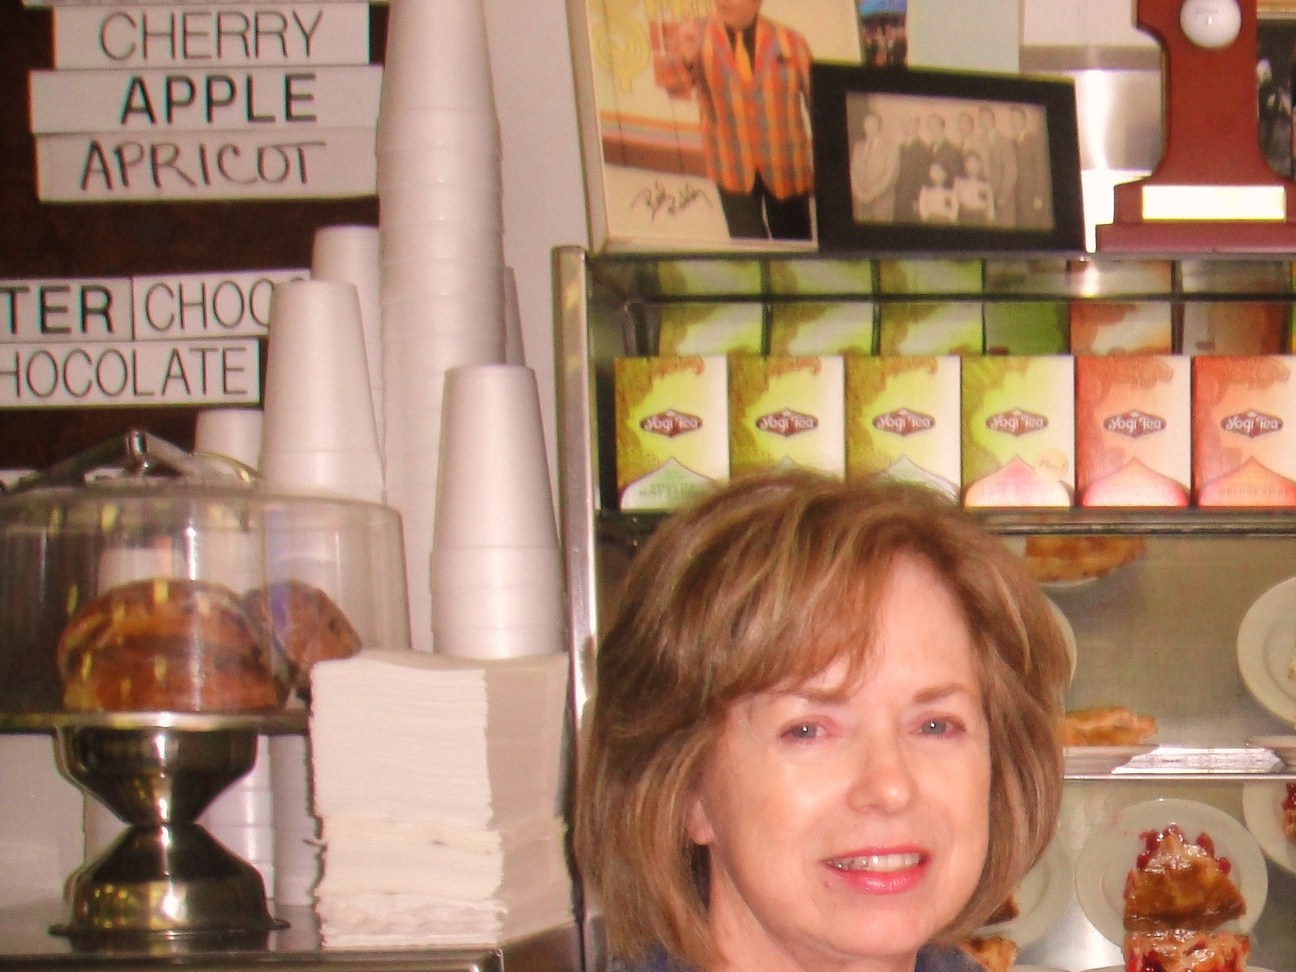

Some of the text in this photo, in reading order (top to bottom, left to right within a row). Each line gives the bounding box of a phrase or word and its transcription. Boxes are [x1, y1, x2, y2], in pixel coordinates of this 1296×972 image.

[100, 10, 323, 61] CHERRY
[120, 73, 318, 125] APPLE
[80, 140, 327, 191] APRICOT
[0, 285, 115, 335] TER
[145, 277, 304, 333] CHOC
[990, 414, 1044, 431] Yogi Tea
[1107, 416, 1162, 432] Yogi Tea
[1225, 415, 1278, 432] Yogi Tea
